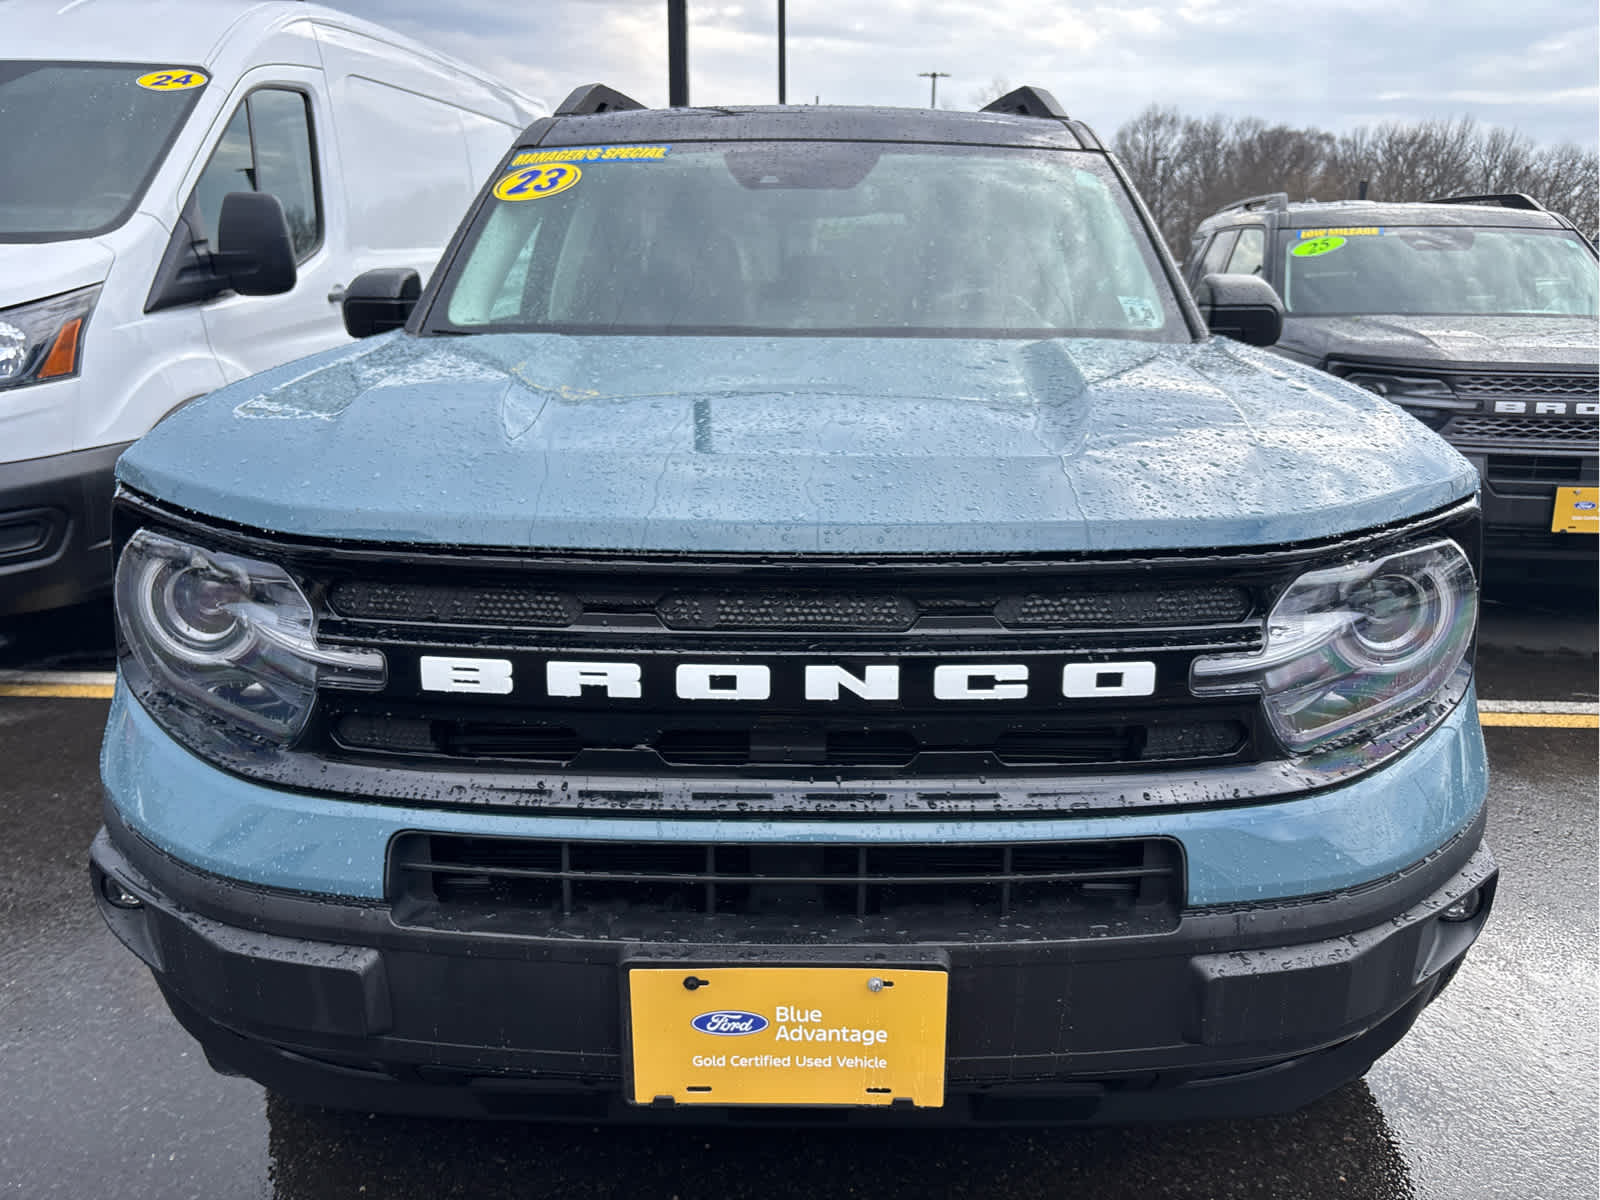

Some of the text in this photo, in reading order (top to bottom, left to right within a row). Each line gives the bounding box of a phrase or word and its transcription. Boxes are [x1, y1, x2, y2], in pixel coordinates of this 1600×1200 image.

[151, 74, 193, 86] 24
[511, 147, 668, 166] MANAGER'S SPECIAL
[506, 168, 567, 195] 23
[420, 655, 1156, 700] BRONCO
[705, 1013, 754, 1033] Ford
[775, 1006, 823, 1023] Blue
[775, 1025, 888, 1046] Advantage
[692, 1054, 888, 1069] Gold Certified Used Vehicle
